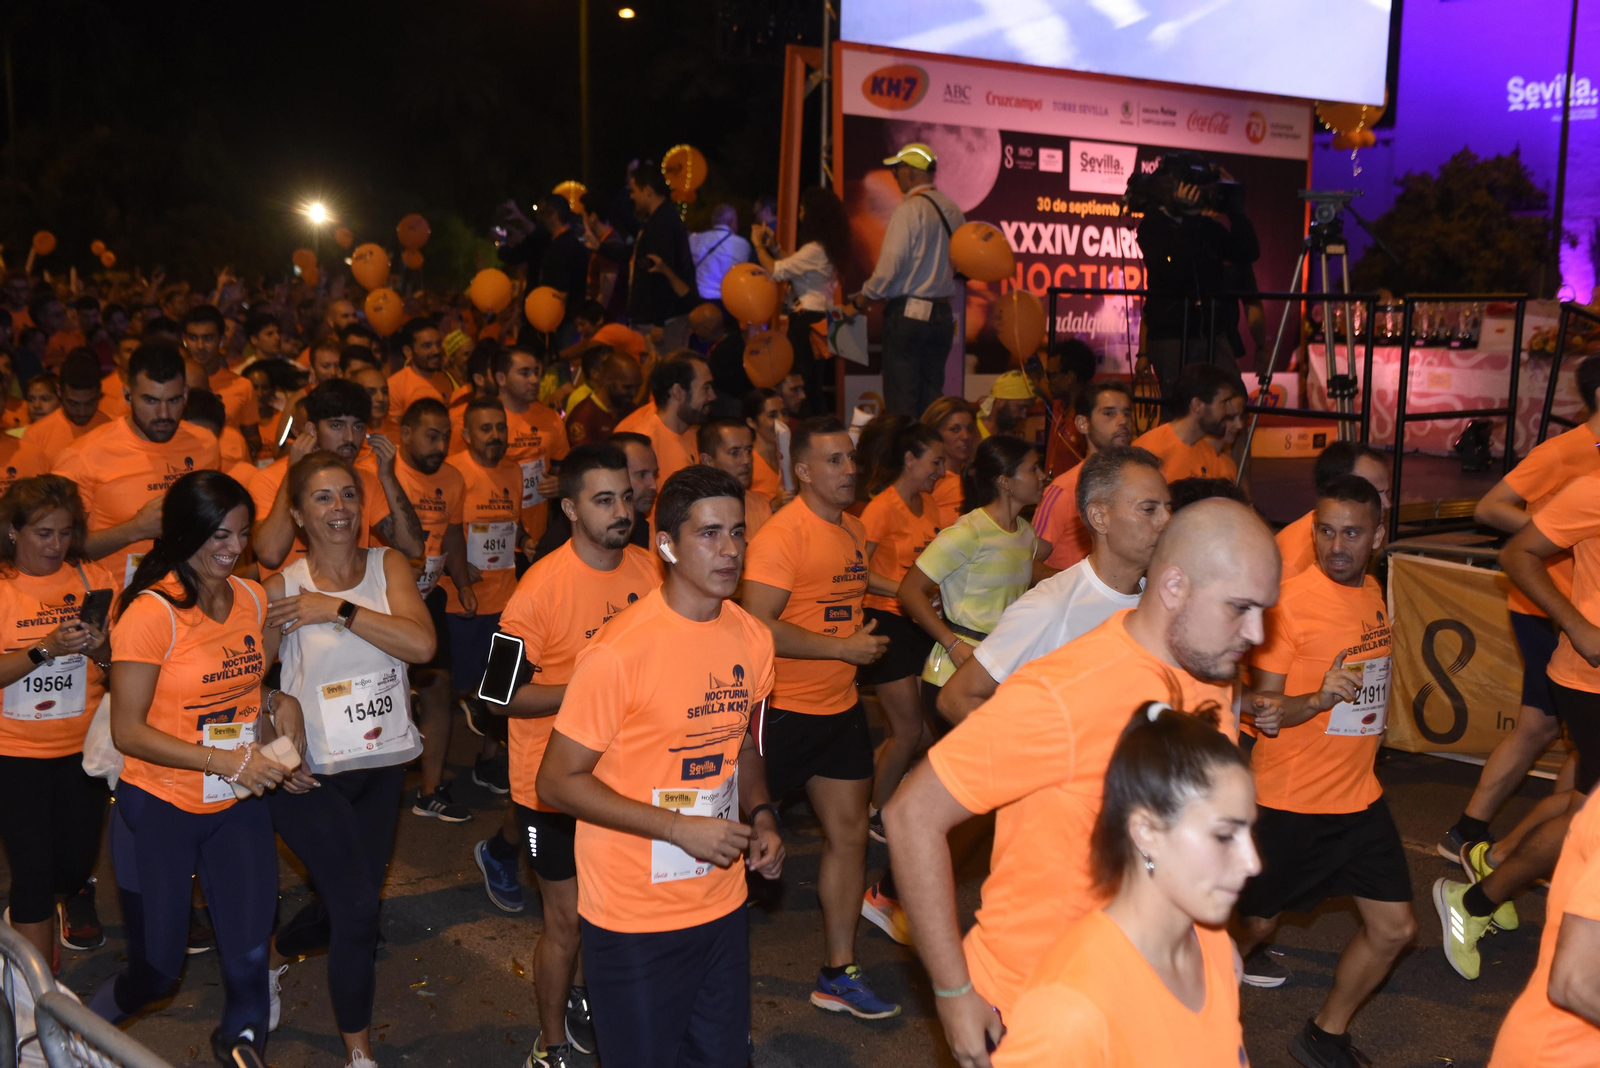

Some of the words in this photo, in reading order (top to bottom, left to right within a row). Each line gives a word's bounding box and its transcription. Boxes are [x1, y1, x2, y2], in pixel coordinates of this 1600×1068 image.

[943, 84, 971, 100] ABC
[985, 91, 1043, 112] Cruzcampo
[1037, 196, 1051, 212] 30
[1053, 198, 1067, 213] de
[1000, 220, 1080, 256] XXXIV
[483, 538, 506, 551] 4814
[832, 574, 857, 583] SEVILLA
[16, 616, 58, 628] SEVILLA
[1347, 641, 1378, 656] SEVILLA
[222, 653, 262, 669] NOCTURNA
[23, 674, 73, 693] 19564
[202, 667, 243, 684] SEVILLA
[705, 689, 748, 701] NOCTURNA
[1352, 683, 1386, 705] 21911
[344, 695, 393, 723] 15429
[687, 703, 725, 719] SEVILLA
